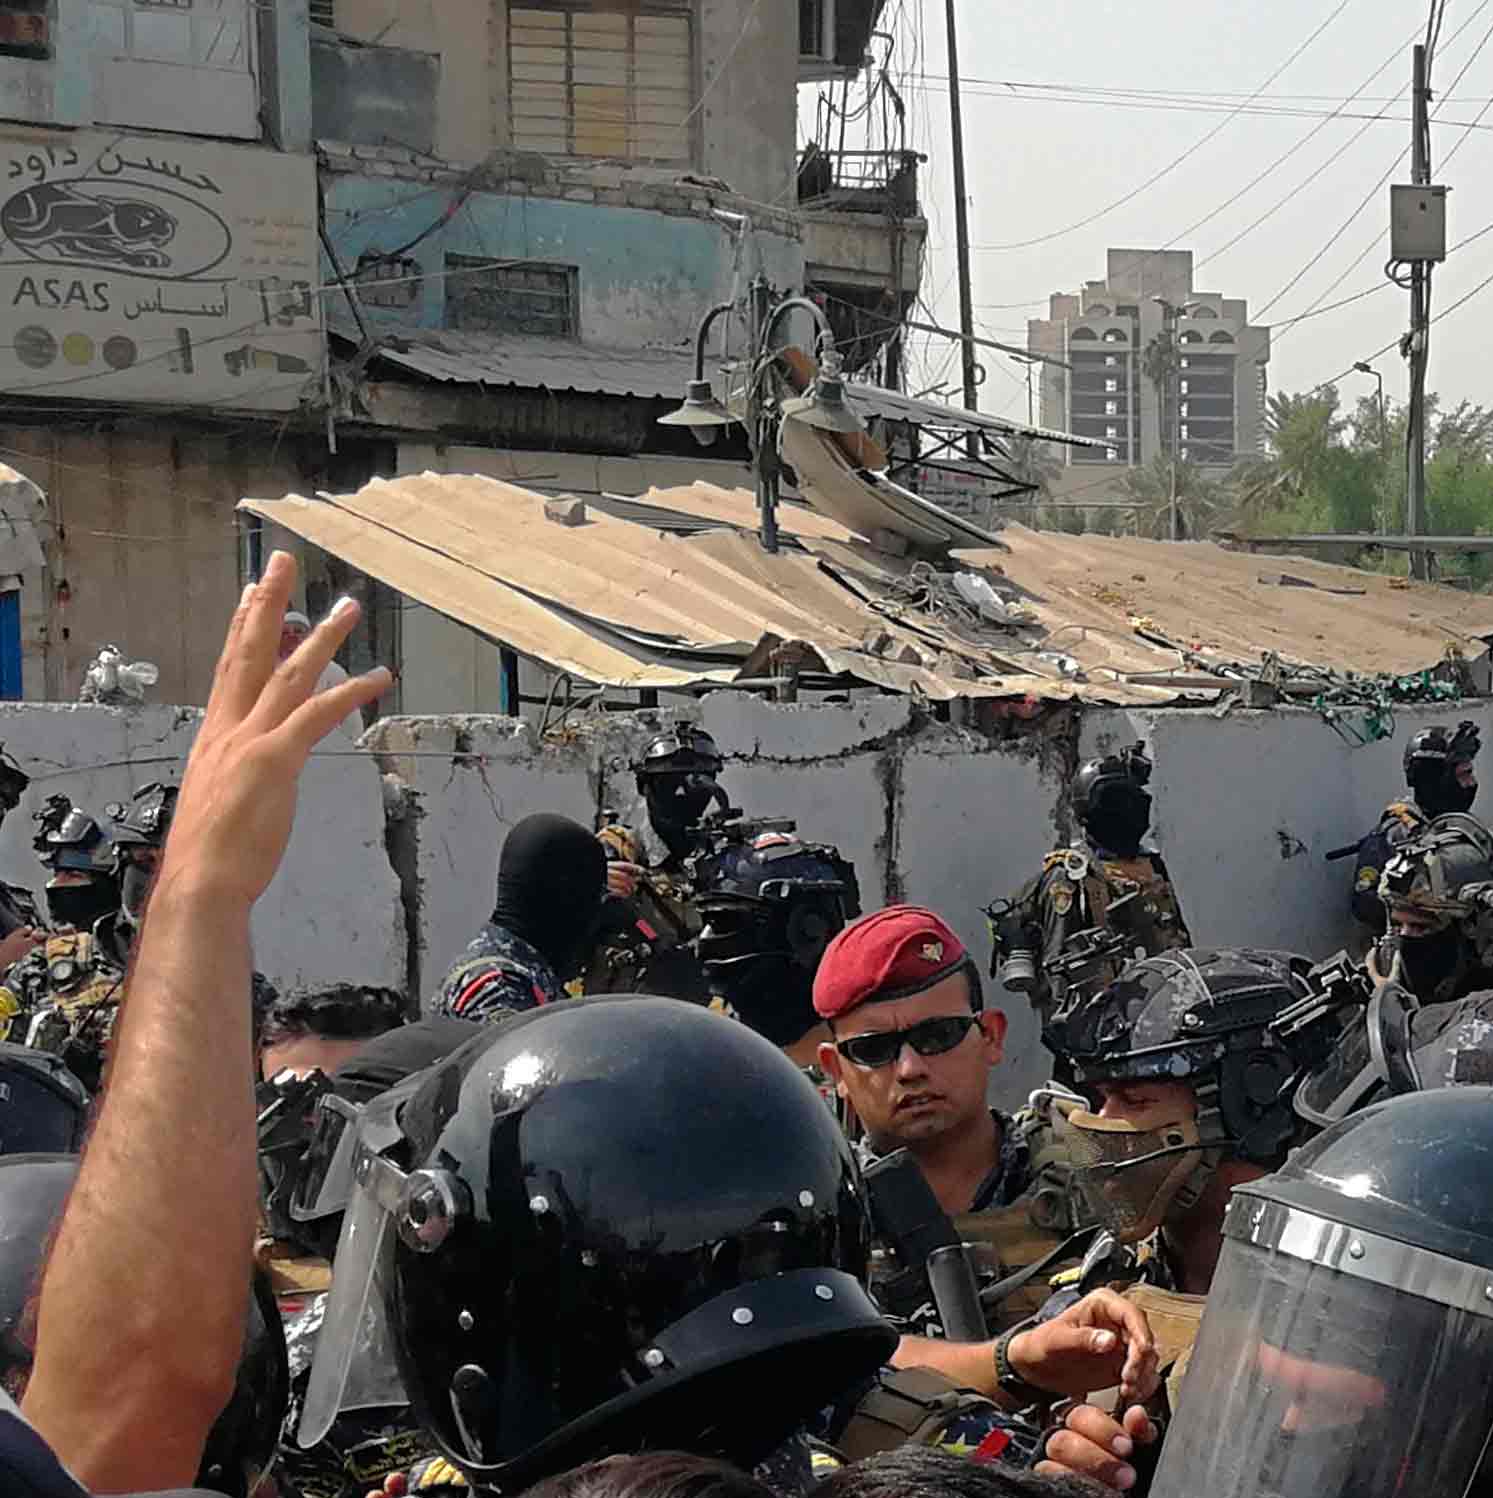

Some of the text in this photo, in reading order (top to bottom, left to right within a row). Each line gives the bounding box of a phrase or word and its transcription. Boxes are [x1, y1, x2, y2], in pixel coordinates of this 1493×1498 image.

[8, 145, 222, 194] حسن داود
[13, 277, 109, 312] ASAS
